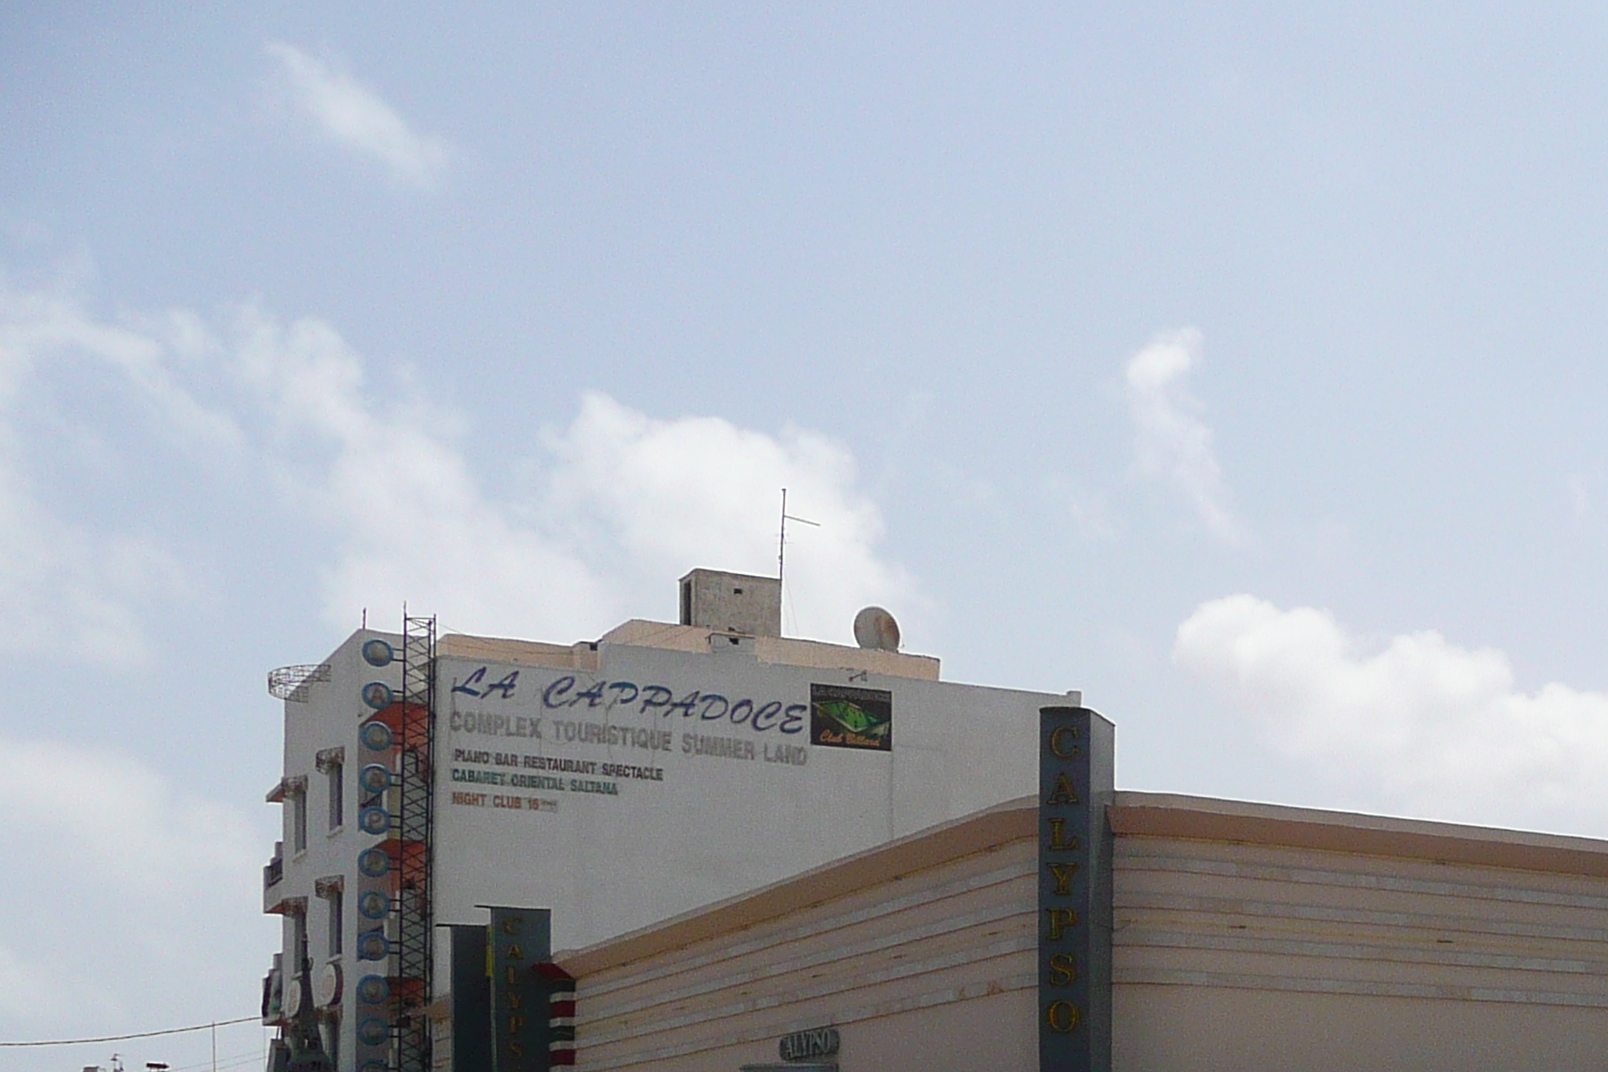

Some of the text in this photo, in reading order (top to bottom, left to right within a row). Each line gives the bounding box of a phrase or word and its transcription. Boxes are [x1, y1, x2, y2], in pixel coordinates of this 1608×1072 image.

[451, 666, 808, 734] LA CAPPADOCE
[449, 710, 808, 767] COMPLEX TOURISTIQUE SUMMER LAND
[451, 768, 507, 787] CABARET
[511, 775, 566, 792] ORIENTAL
[454, 748, 664, 782] PIANO BAR RESTAURANT SPECTACLE
[452, 791, 488, 807] NIGHT
[493, 794, 523, 810] CLUB
[1045, 725, 1079, 1033] CALYPSO
